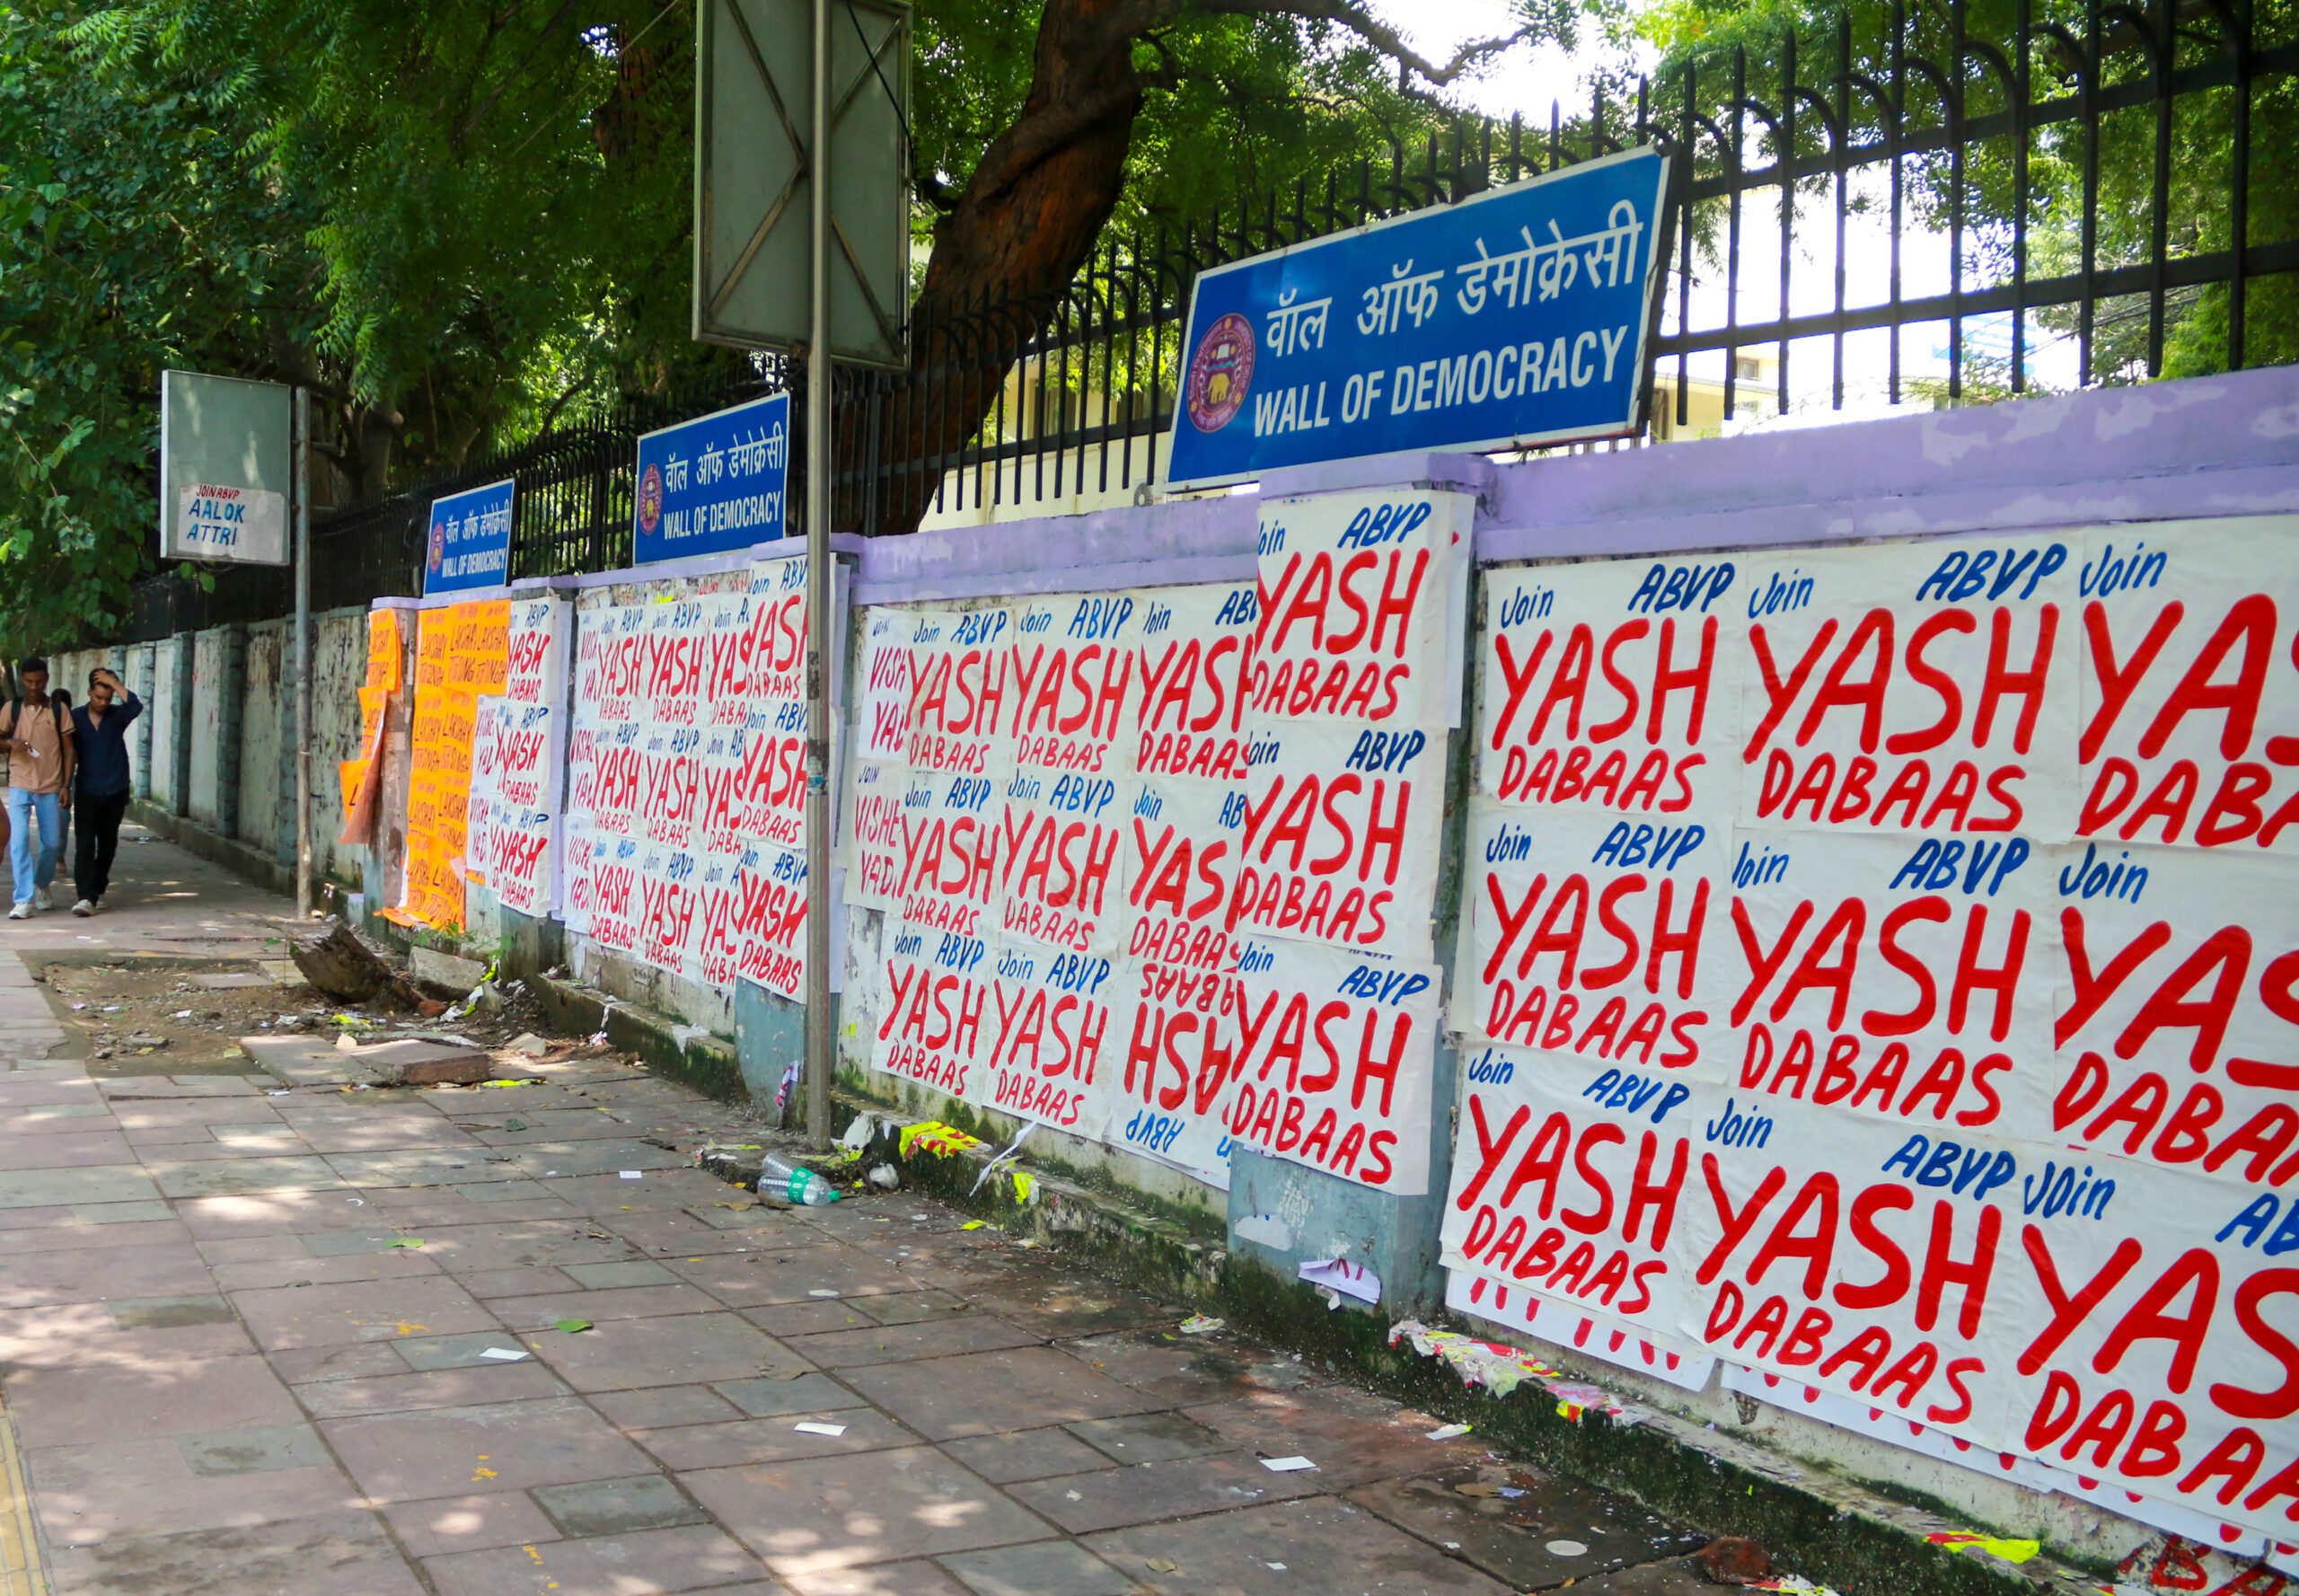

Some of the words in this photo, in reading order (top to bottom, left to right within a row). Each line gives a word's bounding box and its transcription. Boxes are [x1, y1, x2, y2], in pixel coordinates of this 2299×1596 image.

[1266, 288, 1332, 357] वॉल
[1357, 259, 1444, 336] ऑफ
[1456, 199, 1643, 314] डेमोक्रेसी
[1255, 381, 1330, 437] WALL
[1342, 370, 1385, 423] OF
[1390, 325, 1628, 416] DEMOCRACY
[665, 453, 688, 492] वॉल
[697, 442, 724, 485] ऑफ
[728, 421, 784, 478] डेमोक्रेसी
[187, 524, 237, 545] ATTRI
[189, 498, 245, 524] AALOK
[446, 515, 459, 544] वॉल
[462, 509, 479, 540] ऑफ
[665, 509, 691, 540] WALL
[694, 504, 707, 535] OF
[709, 491, 781, 532] DEMOCRACY
[1337, 501, 1431, 550] ABVP
[442, 557, 456, 578] WALL
[458, 555, 466, 575] OF
[467, 548, 506, 574] DEMOCRACY
[1748, 568, 1814, 619] Join
[1916, 543, 2067, 602] ABVP
[2080, 542, 2167, 597] Join
[525, 604, 549, 628] ABVP
[620, 609, 643, 631] ABVP
[672, 603, 701, 629] ABVP
[715, 604, 731, 628] Join
[1020, 604, 1052, 634] Join
[1067, 598, 1132, 639] ABVP
[1254, 547, 1430, 659] YASH
[1501, 585, 1554, 629] Join
[1627, 562, 1735, 613] ABVP
[507, 630, 551, 675] YASH
[913, 618, 940, 643] Join
[950, 611, 1007, 646] ABVP
[508, 678, 541, 703] DABAAS
[598, 633, 647, 701] YASH
[648, 633, 705, 700] YASH
[746, 672, 801, 700] DABAAS
[904, 648, 1008, 736] YASH
[1012, 643, 1133, 742] YASH
[1252, 657, 1410, 721] DABAAS
[1491, 615, 1719, 751] YASH
[1743, 603, 2059, 763] YASH
[521, 707, 549, 730] ABVP
[599, 699, 631, 720] DABAAS
[616, 723, 639, 745] ABVP
[654, 700, 697, 726] DABAAS
[744, 703, 765, 729] Join
[647, 730, 663, 751] Join
[671, 728, 699, 754] ABVP
[707, 733, 723, 755] Join
[909, 733, 990, 774] DABAAS
[1017, 734, 1107, 772] DABAAS
[1346, 729, 1426, 774] ABVP
[505, 780, 538, 806] DABAAS
[592, 745, 641, 812] YASH
[644, 754, 700, 822] YASH
[905, 780, 932, 808] Join
[945, 776, 991, 812] ABVP
[1008, 768, 1041, 800] Join
[1050, 774, 1114, 818] ABVP
[1133, 784, 1162, 822] Join
[1498, 745, 1706, 812] DABAAS
[1757, 748, 2026, 832] DABAAS
[518, 807, 549, 831] ABVP
[595, 809, 631, 833] DABAAS
[647, 817, 691, 849] DABAAS
[742, 804, 802, 843] DABAAS
[1242, 773, 1411, 886] YASH
[500, 828, 547, 880] YASH
[644, 850, 659, 871] Join
[666, 853, 693, 882] ABVP
[705, 860, 723, 883] Join
[740, 841, 759, 869] Join
[897, 812, 1000, 904] YASH
[1002, 803, 1119, 916] YASH
[1485, 823, 1532, 863] Join
[1591, 821, 1705, 871] ABVP
[1731, 842, 1790, 888] Join
[1889, 837, 2030, 896] ABVP
[2059, 842, 2148, 903] Join
[501, 877, 533, 909] DABAAS
[594, 862, 635, 918] YASH
[640, 874, 696, 949] YASH
[738, 869, 807, 948] YASH
[903, 894, 980, 936] DABAAS
[1239, 866, 1394, 944] DABAAS
[590, 914, 636, 950] DABAAS
[894, 925, 921, 957] Join
[935, 932, 984, 972] ABVP
[1004, 896, 1095, 951] DABAAS
[1483, 871, 1710, 1000] YASH
[646, 939, 683, 974] DABAAS
[739, 939, 802, 994] DABAAS
[998, 948, 1034, 980] Join
[1045, 953, 1110, 995] ABVP
[1731, 895, 2031, 1042] YASH
[878, 959, 986, 1059] YASH
[1337, 966, 1430, 1006] ABVP
[990, 979, 1107, 1085] YASH
[1231, 980, 1413, 1118] YASH
[1486, 979, 1707, 1068] DABAAS
[887, 1037, 968, 1096] DABAAS
[1468, 1047, 1514, 1085] Join
[1582, 1068, 1690, 1124] ABVP
[1739, 1022, 2013, 1126] DABAAS
[995, 1069, 1085, 1125] DABAAS
[1231, 1082, 1397, 1185] DABAAS
[1706, 1098, 1773, 1149] Join
[1882, 1134, 2016, 1200] ABVP
[1457, 1093, 1690, 1252] YASH
[1462, 1204, 1668, 1315] DABAAS
[1696, 1152, 2002, 1340] YASH
[1704, 1280, 1985, 1424] DABAAS
